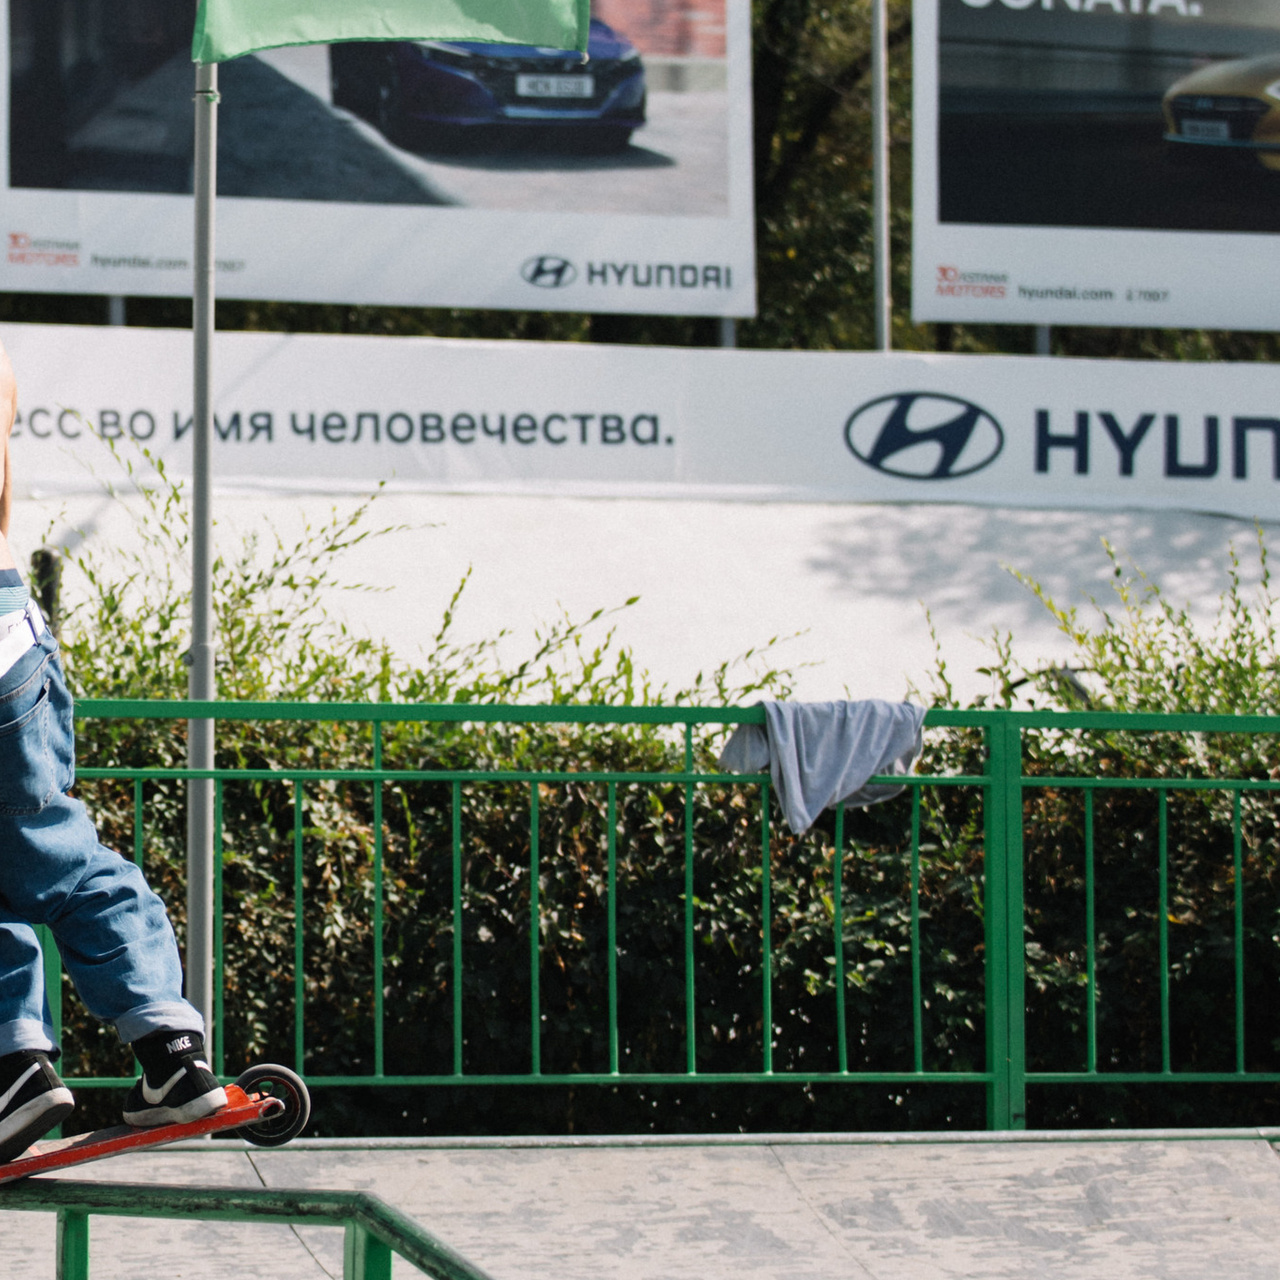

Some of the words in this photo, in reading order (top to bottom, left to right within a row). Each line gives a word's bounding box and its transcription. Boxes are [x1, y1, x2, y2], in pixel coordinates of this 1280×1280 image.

[90, 253, 189, 272] hyundai.com
[587, 262, 732, 290] HYUNDAI
[935, 284, 1007, 299] MOTORS
[1017, 284, 1115, 302] hyundai.com
[99, 408, 156, 440] во
[172, 410, 273, 443] имя
[290, 410, 675, 447] человечества.
[165, 1035, 193, 1054] NIKE
